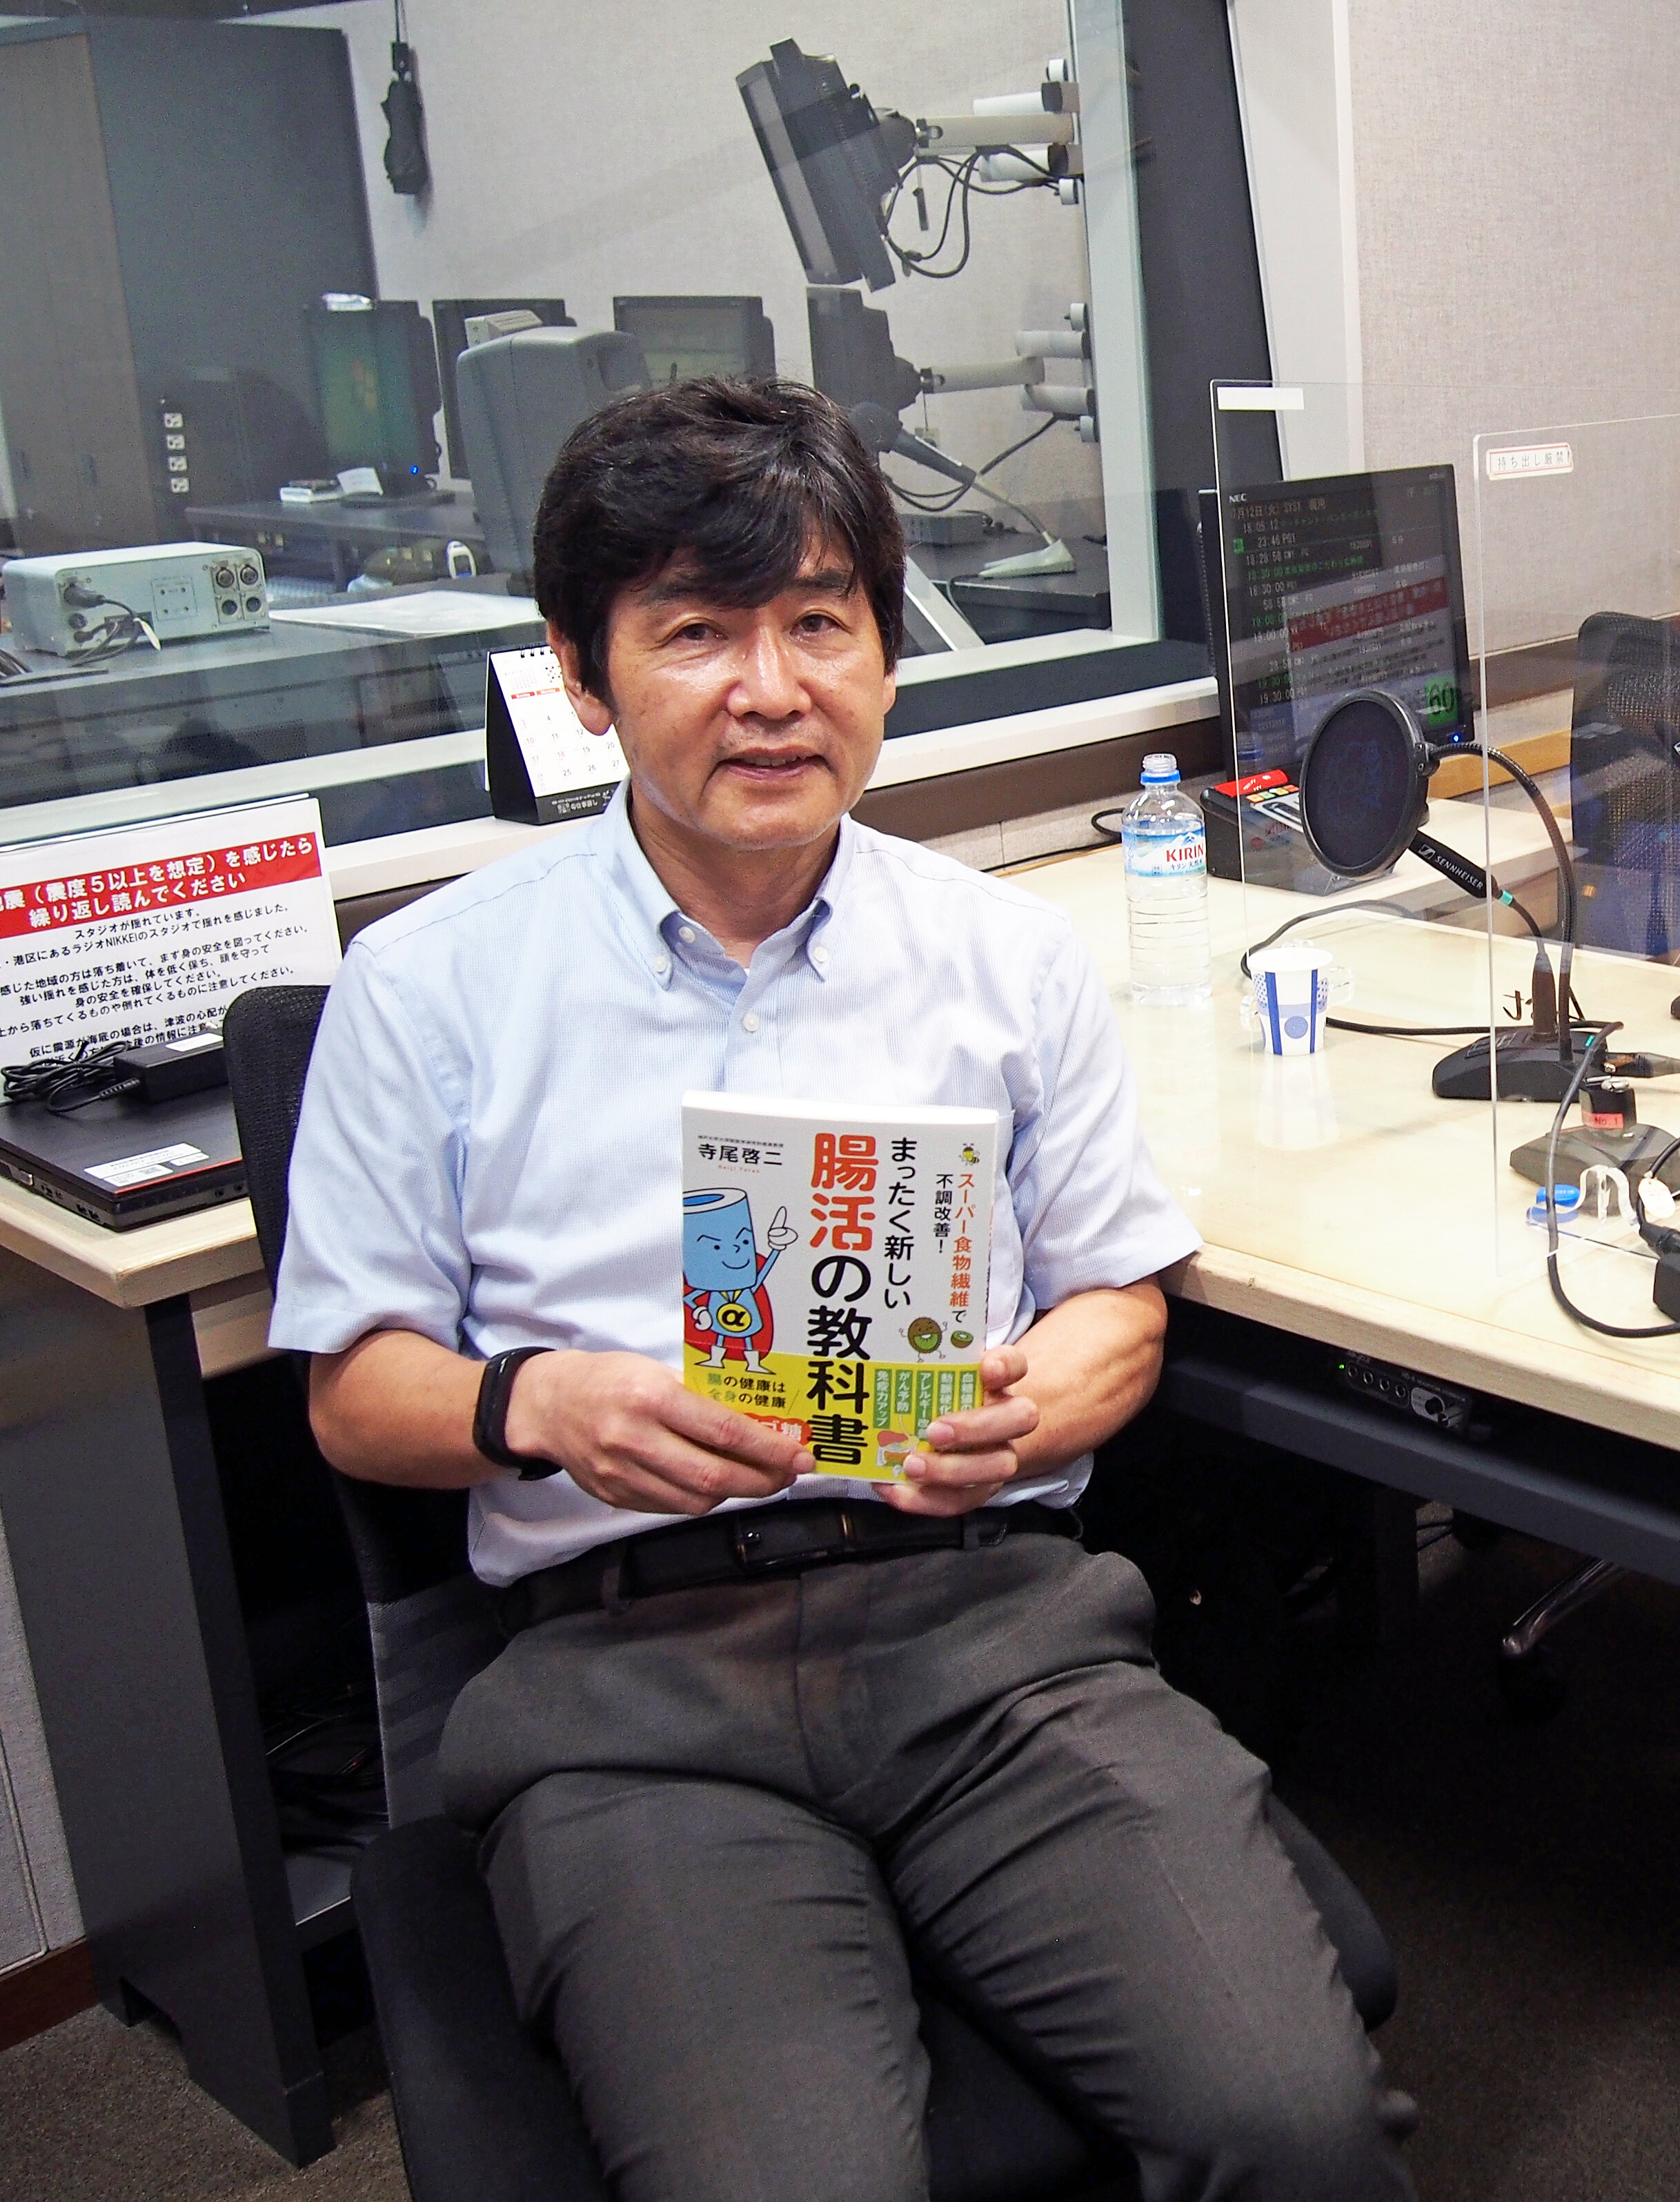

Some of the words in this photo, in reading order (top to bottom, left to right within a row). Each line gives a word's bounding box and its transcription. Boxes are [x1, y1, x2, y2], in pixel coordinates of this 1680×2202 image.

[1229, 493, 1247, 504] NEC
[563, 768, 572, 777] 25
[0, 838, 313, 911] 震（震度5以上を想定）を感じたら
[1166, 842, 1204, 862] KIRIN
[1434, 855, 1484, 890] SENNHEISER
[29, 872, 246, 929] 繰り返し読んでください
[75, 908, 199, 940] スタジオが揺れています。
[0, 903, 288, 969] ・港区にあるラジオNIKKEIのスタジオで揺れを感じました。
[75, 969, 221, 1009] 身の安全を確保してください。
[698, 1142, 783, 1167] 寺尾啓二
[884, 1137, 918, 1309] まったく新しい
[933, 1173, 953, 1253] 不調改善！
[949, 1173, 976, 1323] スーパー食物繊維で
[807, 1132, 877, 1465] 腸活の教科書
